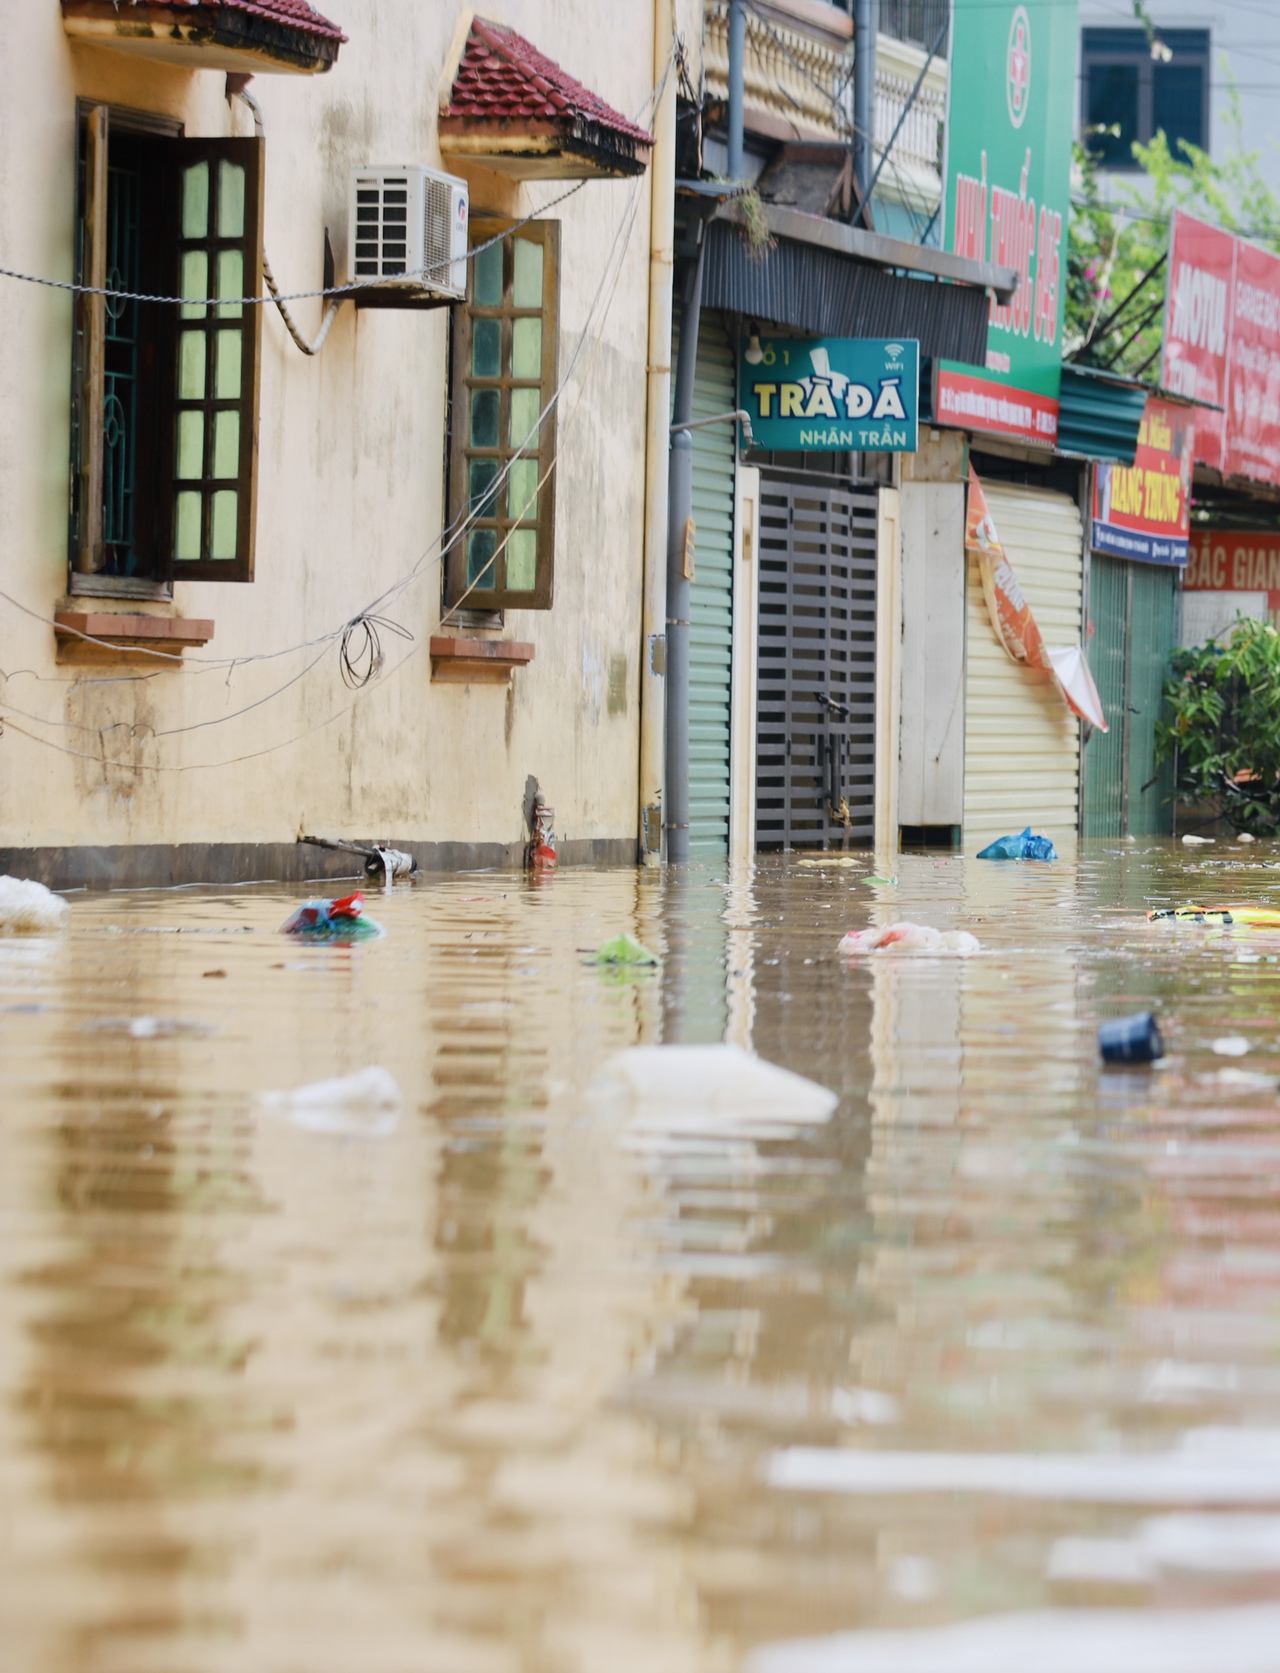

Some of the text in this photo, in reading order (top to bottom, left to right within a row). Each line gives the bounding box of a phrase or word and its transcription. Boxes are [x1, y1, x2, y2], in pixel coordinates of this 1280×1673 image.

[754, 377, 837, 417] TRÀ
[846, 378, 907, 419] ĐÁ
[799, 423, 907, 447] NHÂN TRẦN
